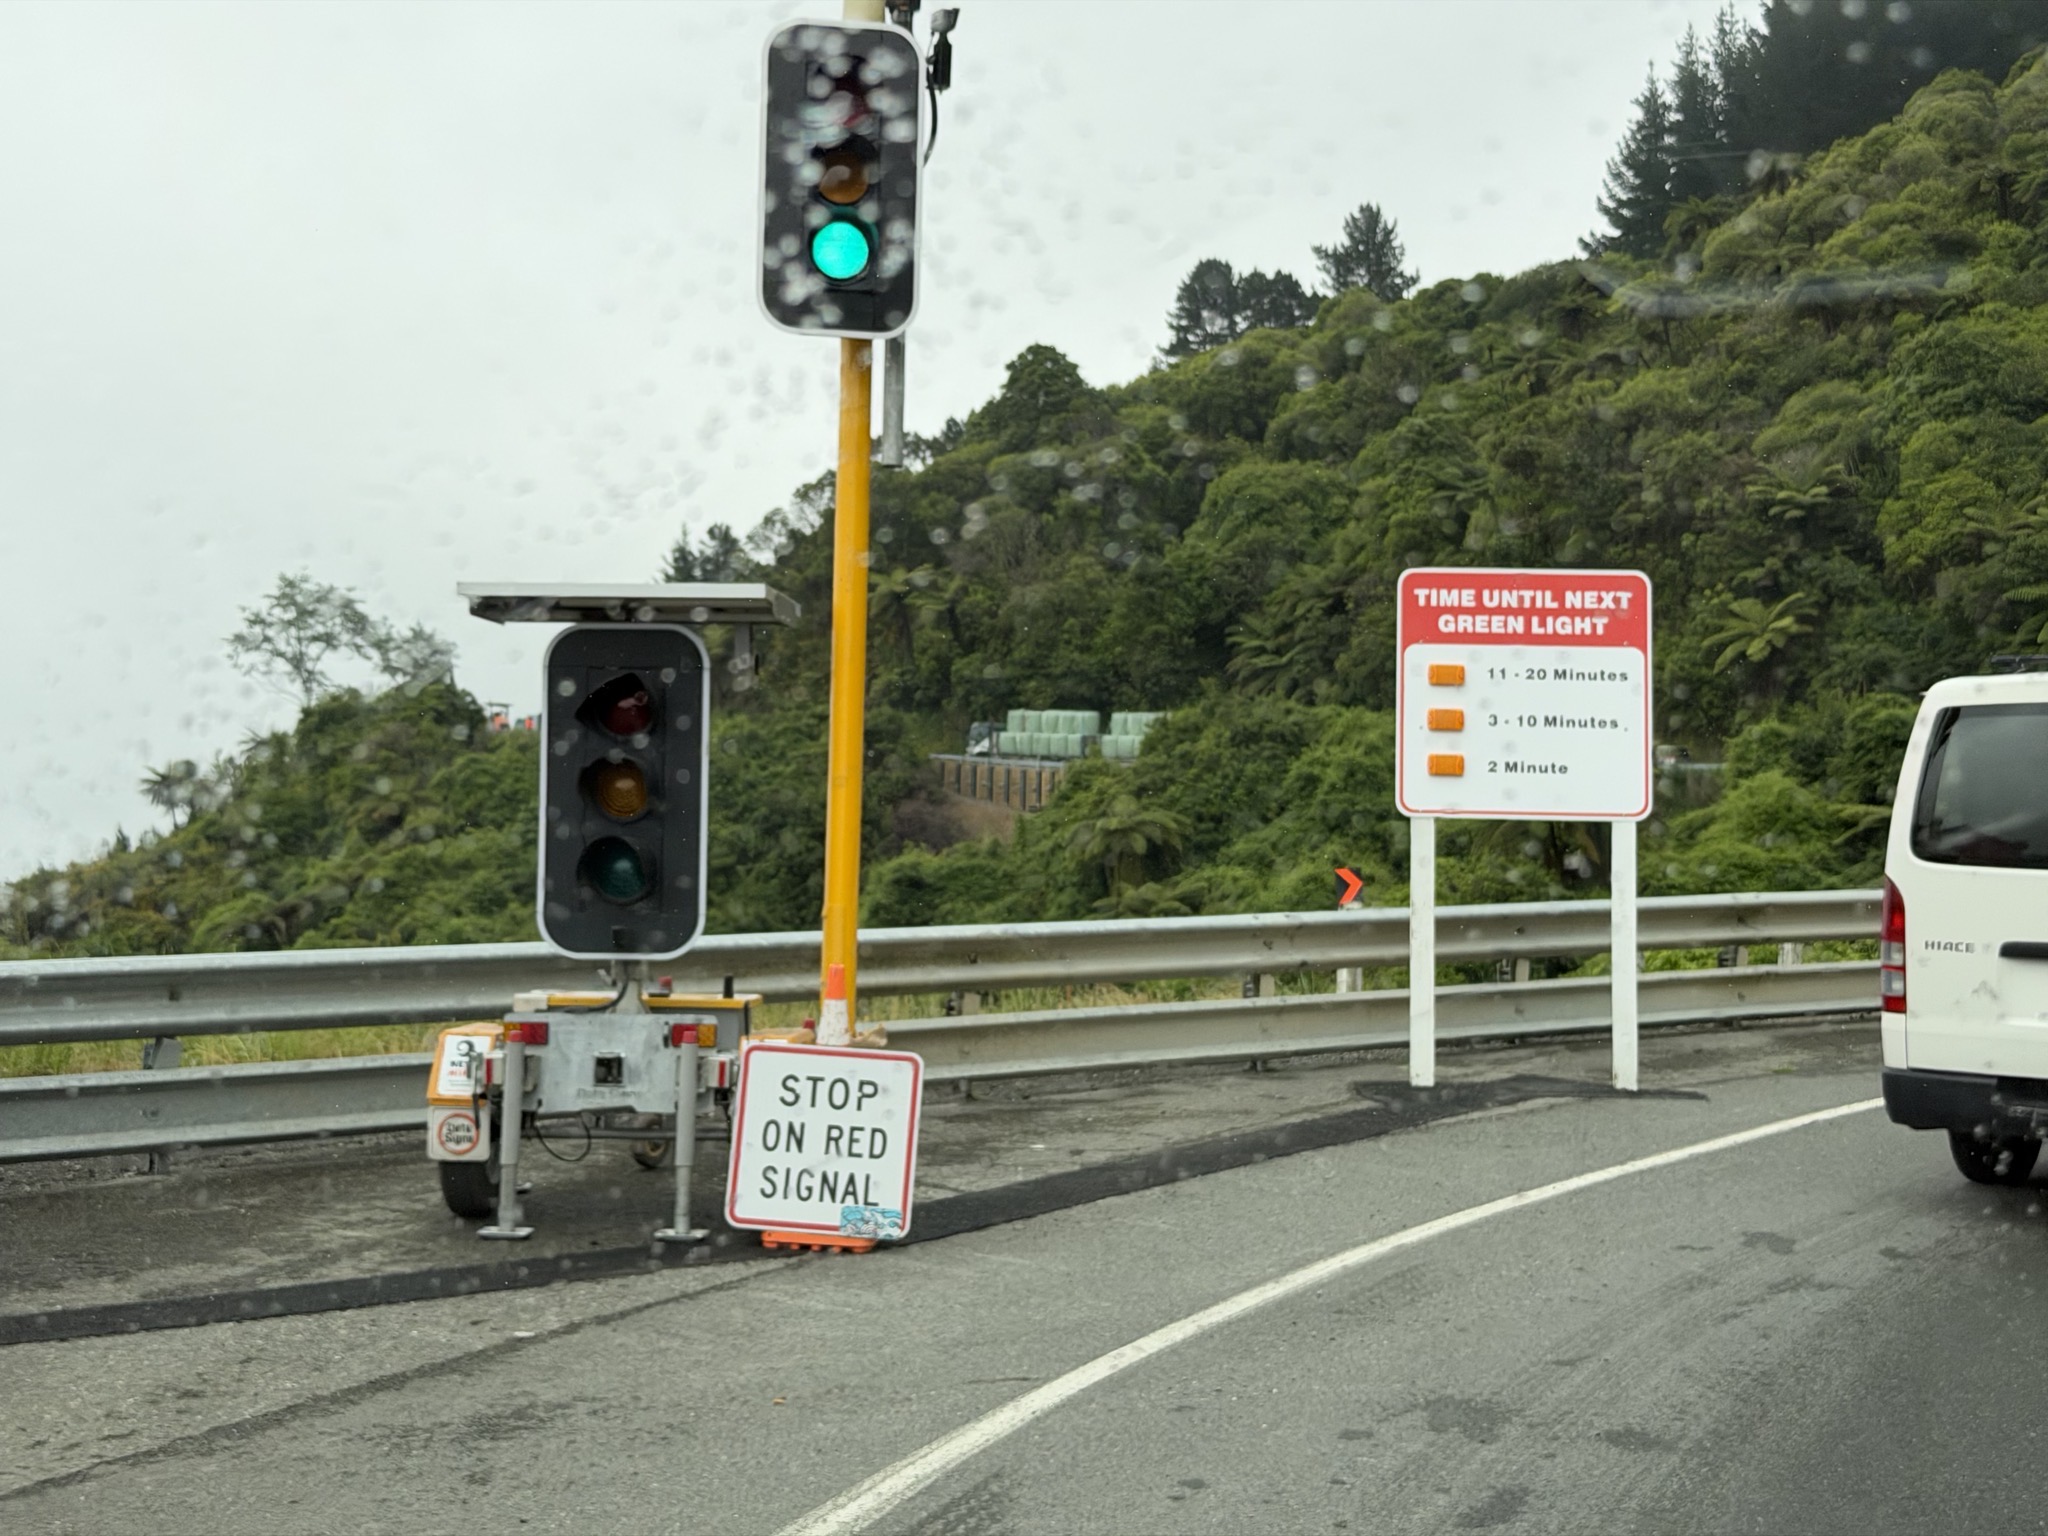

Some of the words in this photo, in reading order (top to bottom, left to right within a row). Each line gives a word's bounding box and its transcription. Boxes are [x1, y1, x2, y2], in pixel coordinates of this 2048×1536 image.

[1414, 588, 1476, 607] TIME
[1482, 589, 1559, 609] UNTIL
[1565, 591, 1633, 610] NEXT
[1438, 614, 1525, 634] GREEN
[1531, 616, 1609, 635] LIGHT
[1487, 667, 1507, 680] 11
[1525, 668, 1547, 681] 20
[1553, 668, 1629, 682] Minutes
[1488, 714, 1498, 727] 3
[1517, 715, 1538, 728] 10
[1543, 715, 1619, 729] Minutes
[1487, 760, 1498, 773] 2
[1504, 761, 1569, 774] Minute
[1924, 940, 1976, 954] HIACE
[779, 1074, 879, 1112] STOP
[762, 1119, 805, 1154] ON
[824, 1124, 888, 1159] RED
[760, 1165, 880, 1207] SIGNAL
